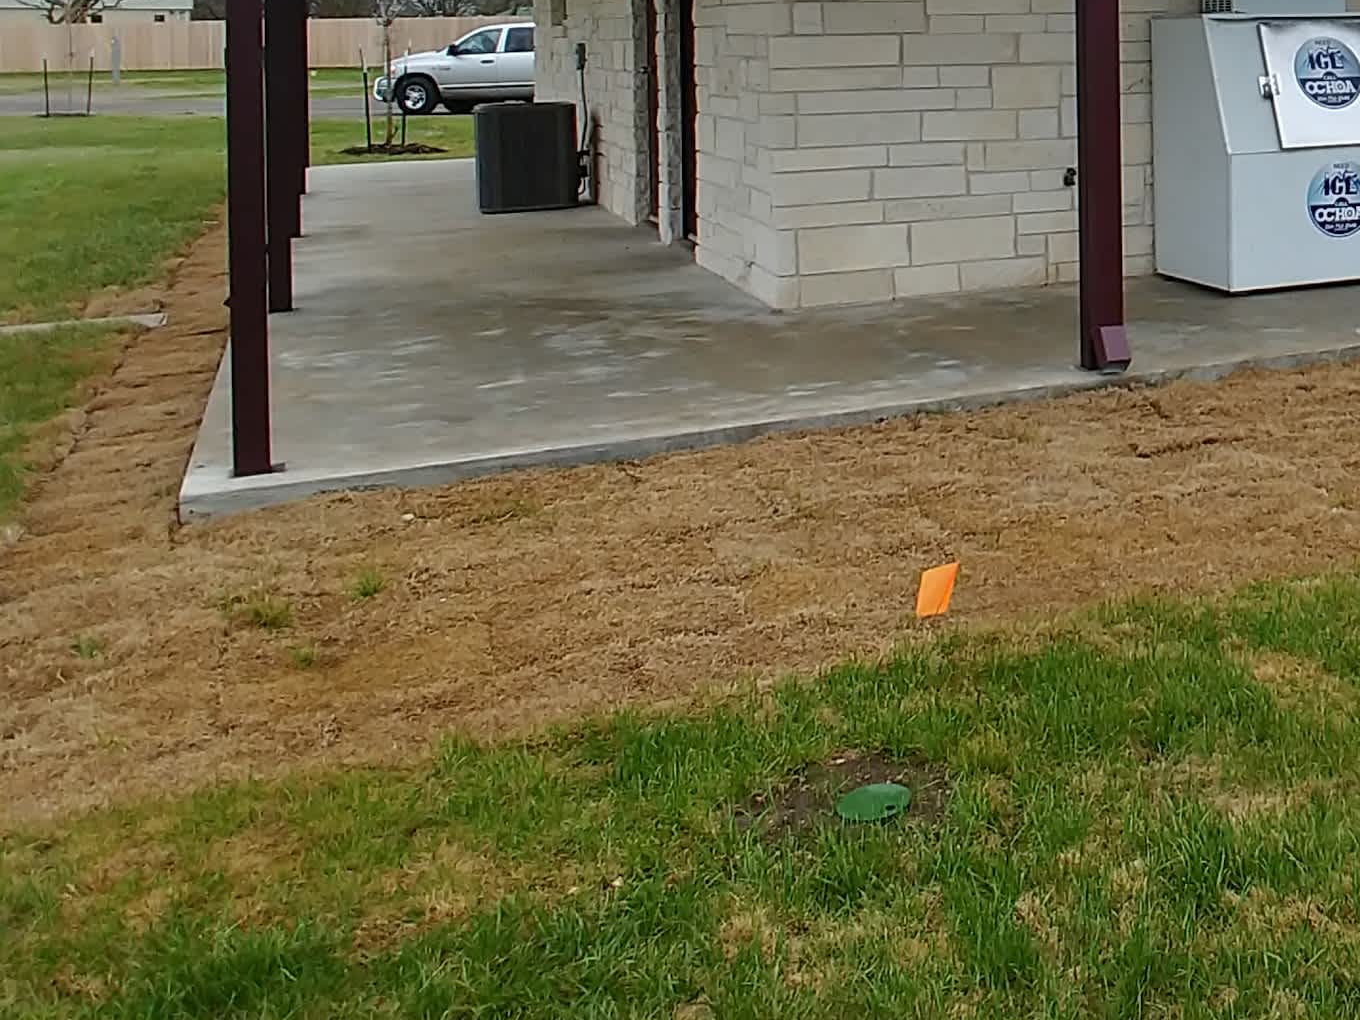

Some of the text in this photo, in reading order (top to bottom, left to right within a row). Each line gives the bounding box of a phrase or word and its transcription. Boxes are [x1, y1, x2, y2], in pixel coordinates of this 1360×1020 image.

[1308, 50, 1345, 70] ICE
[1305, 79, 1357, 95] OCHOA
[1323, 174, 1358, 196] ICE
